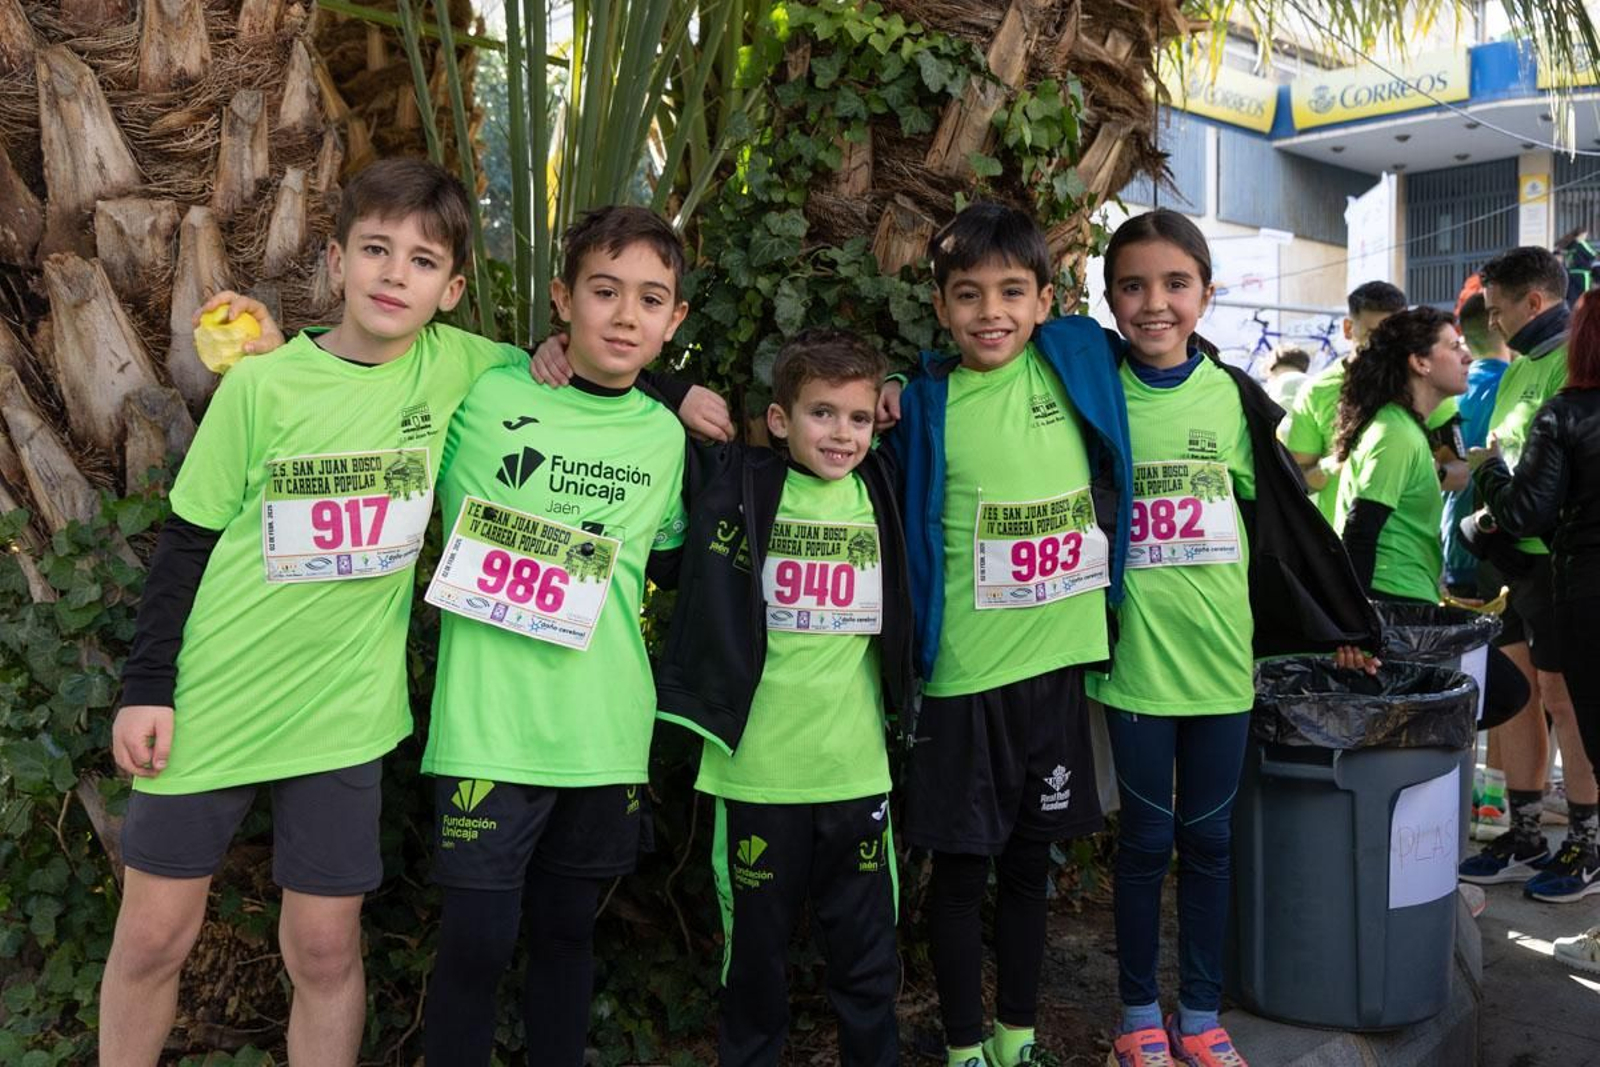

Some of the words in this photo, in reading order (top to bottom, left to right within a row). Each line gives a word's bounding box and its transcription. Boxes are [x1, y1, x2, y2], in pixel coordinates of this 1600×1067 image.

[293, 461, 314, 476] SAN
[319, 459, 348, 475] JUAN
[352, 456, 383, 473] BOSCO
[551, 455, 650, 487] Fundación
[1136, 467, 1159, 480] JUAN
[1162, 465, 1189, 478] BOSCO
[274, 479, 283, 493] IV
[286, 477, 332, 495] CARRERA
[335, 474, 376, 493] POPULAR
[550, 473, 625, 505] Unicaja
[1147, 479, 1183, 495] POPULAR
[545, 500, 580, 515] Jaén
[1003, 507, 1021, 521] SAN
[1025, 504, 1048, 520] JUAN
[1050, 499, 1070, 515] BOSCO
[311, 496, 390, 550] 917
[511, 514, 540, 535] JUAN
[541, 524, 572, 544] BOSCO
[987, 522, 994, 534] IV
[997, 521, 1034, 536] CARRERA
[1036, 514, 1068, 534] POPULAR
[1130, 497, 1205, 543] 982
[469, 518, 481, 533] IV
[480, 521, 518, 548] CARRERA
[518, 533, 559, 557] POPULAR
[773, 523, 791, 538] SAN
[794, 525, 820, 540] JUAN
[823, 527, 848, 541] BOSCO
[805, 541, 841, 556] POPULAR
[1011, 531, 1083, 582] 983
[477, 550, 569, 612] 986
[775, 560, 855, 607] 940
[443, 814, 497, 830] Fundación
[442, 826, 478, 841] Unicaja
